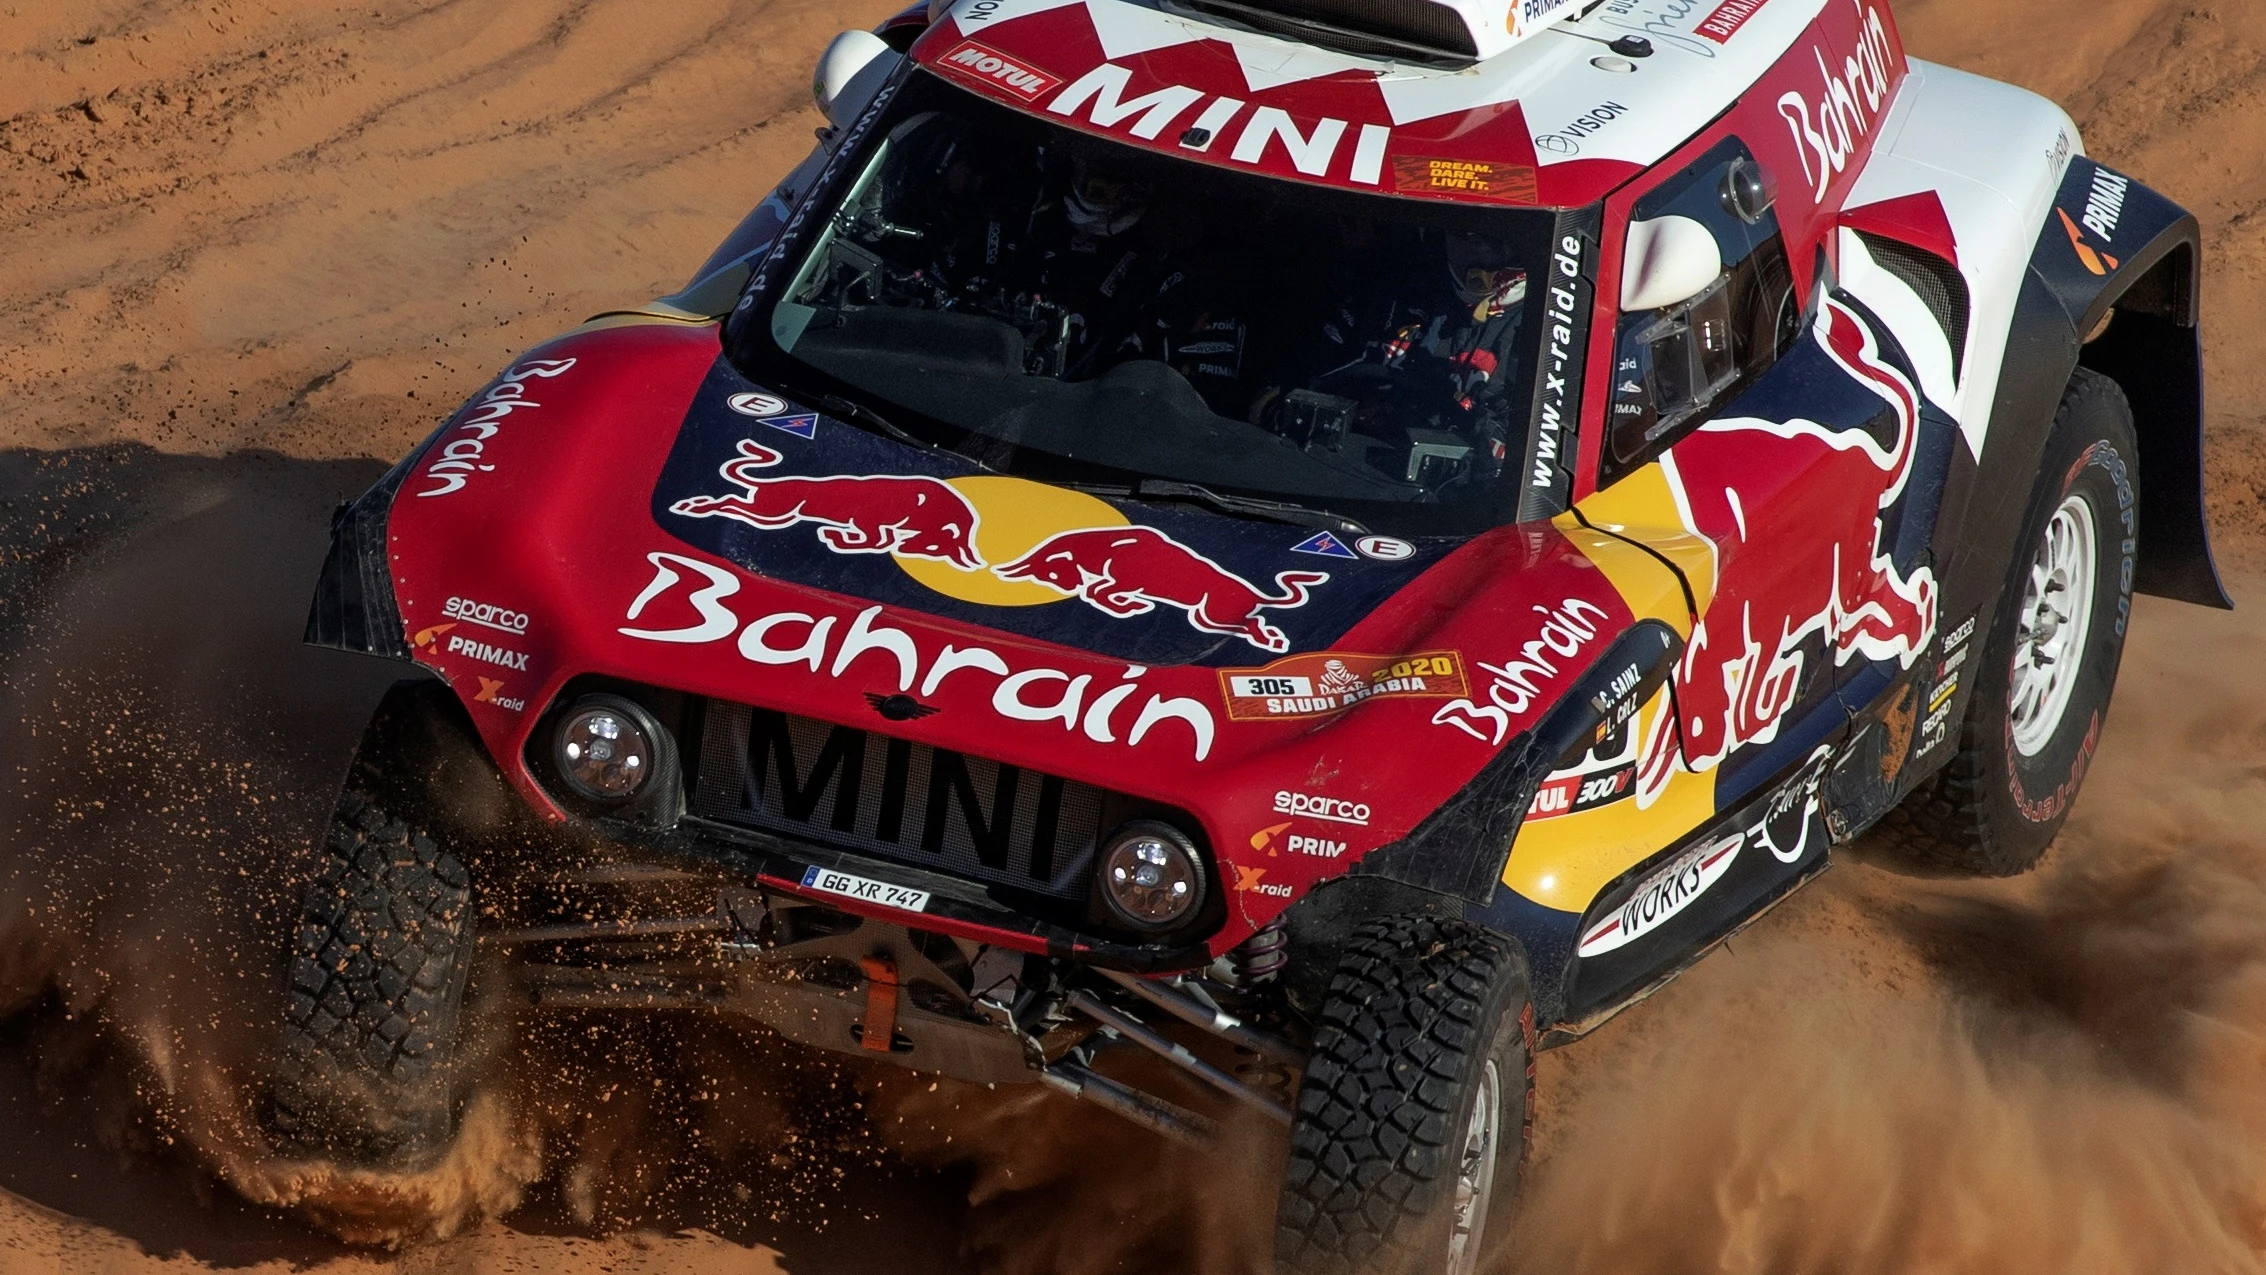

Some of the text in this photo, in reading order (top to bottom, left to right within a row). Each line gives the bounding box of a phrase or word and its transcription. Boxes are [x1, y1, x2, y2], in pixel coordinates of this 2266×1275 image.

[949, 48, 1046, 94] MOTUL
[1560, 100, 1629, 138] VISION
[1777, 0, 1893, 204] Bahrain
[1047, 63, 1391, 186] MINI
[1429, 160, 1493, 174] DREAM.
[1430, 169, 1479, 180] DARE.
[1431, 178, 1490, 191] LIVE IT.
[2082, 166, 2129, 243] PRIMAX
[1533, 235, 1582, 487] www.x-raid.de
[739, 396, 776, 413] E
[417, 357, 577, 498] Bahrain
[1371, 540, 1400, 556] E
[442, 597, 529, 634] sparco
[448, 635, 529, 671] PRIMAX
[617, 551, 1214, 762] Bahrain
[1372, 657, 1453, 683] 2020
[1248, 678, 1295, 696] 305
[1431, 598, 1609, 747] Bahrain
[1610, 662, 1642, 699] SAINZ
[1267, 677, 1428, 713] SAUDI ARABIA
[739, 704, 1066, 883] MINI
[1576, 766, 1635, 805] 300V
[1273, 790, 1370, 826] sparco
[822, 873, 851, 892] GG
[852, 880, 882, 899] XR
[885, 887, 923, 907] 747
[1622, 854, 1707, 937] WORKS
